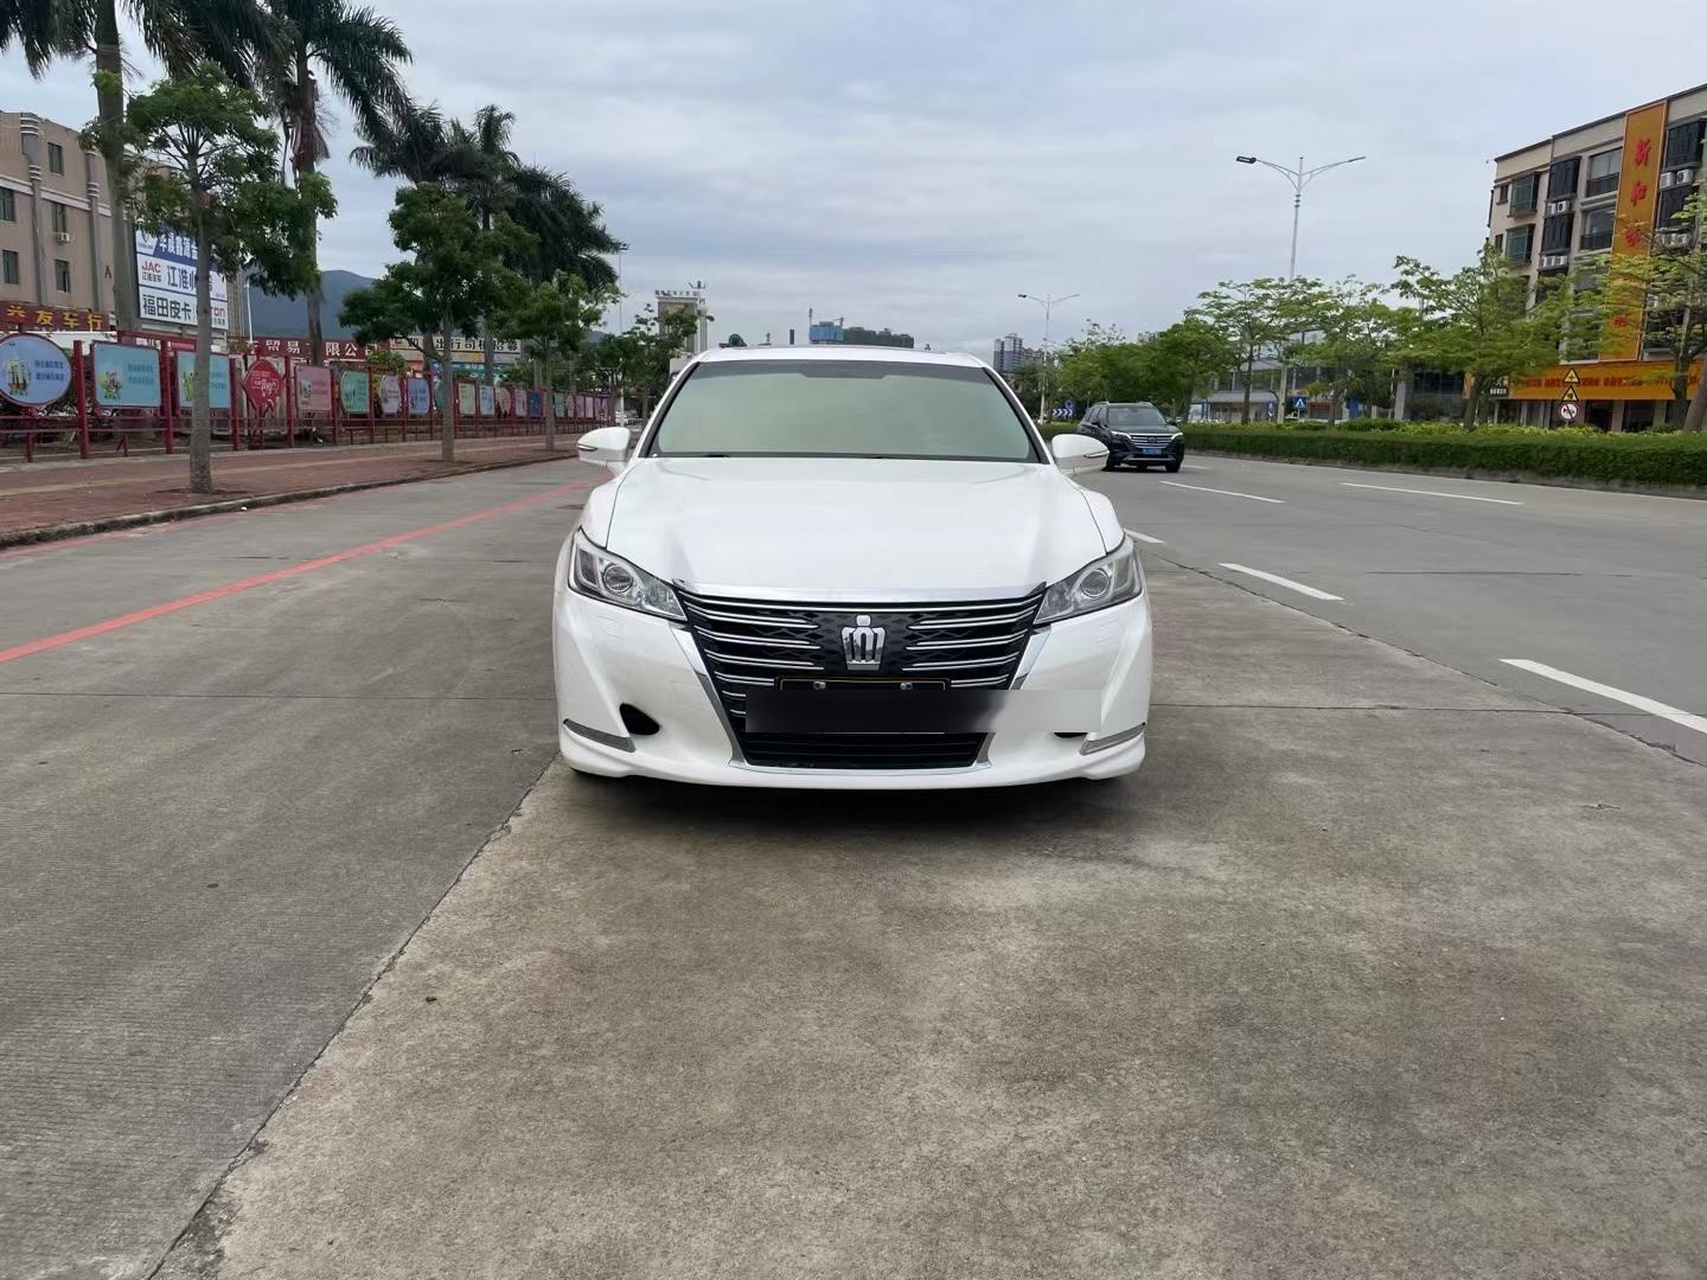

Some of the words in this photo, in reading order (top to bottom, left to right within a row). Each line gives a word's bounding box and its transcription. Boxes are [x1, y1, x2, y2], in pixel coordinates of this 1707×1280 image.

[141, 261, 161, 273] JAC
[142, 294, 193, 321] 福田皮卡
